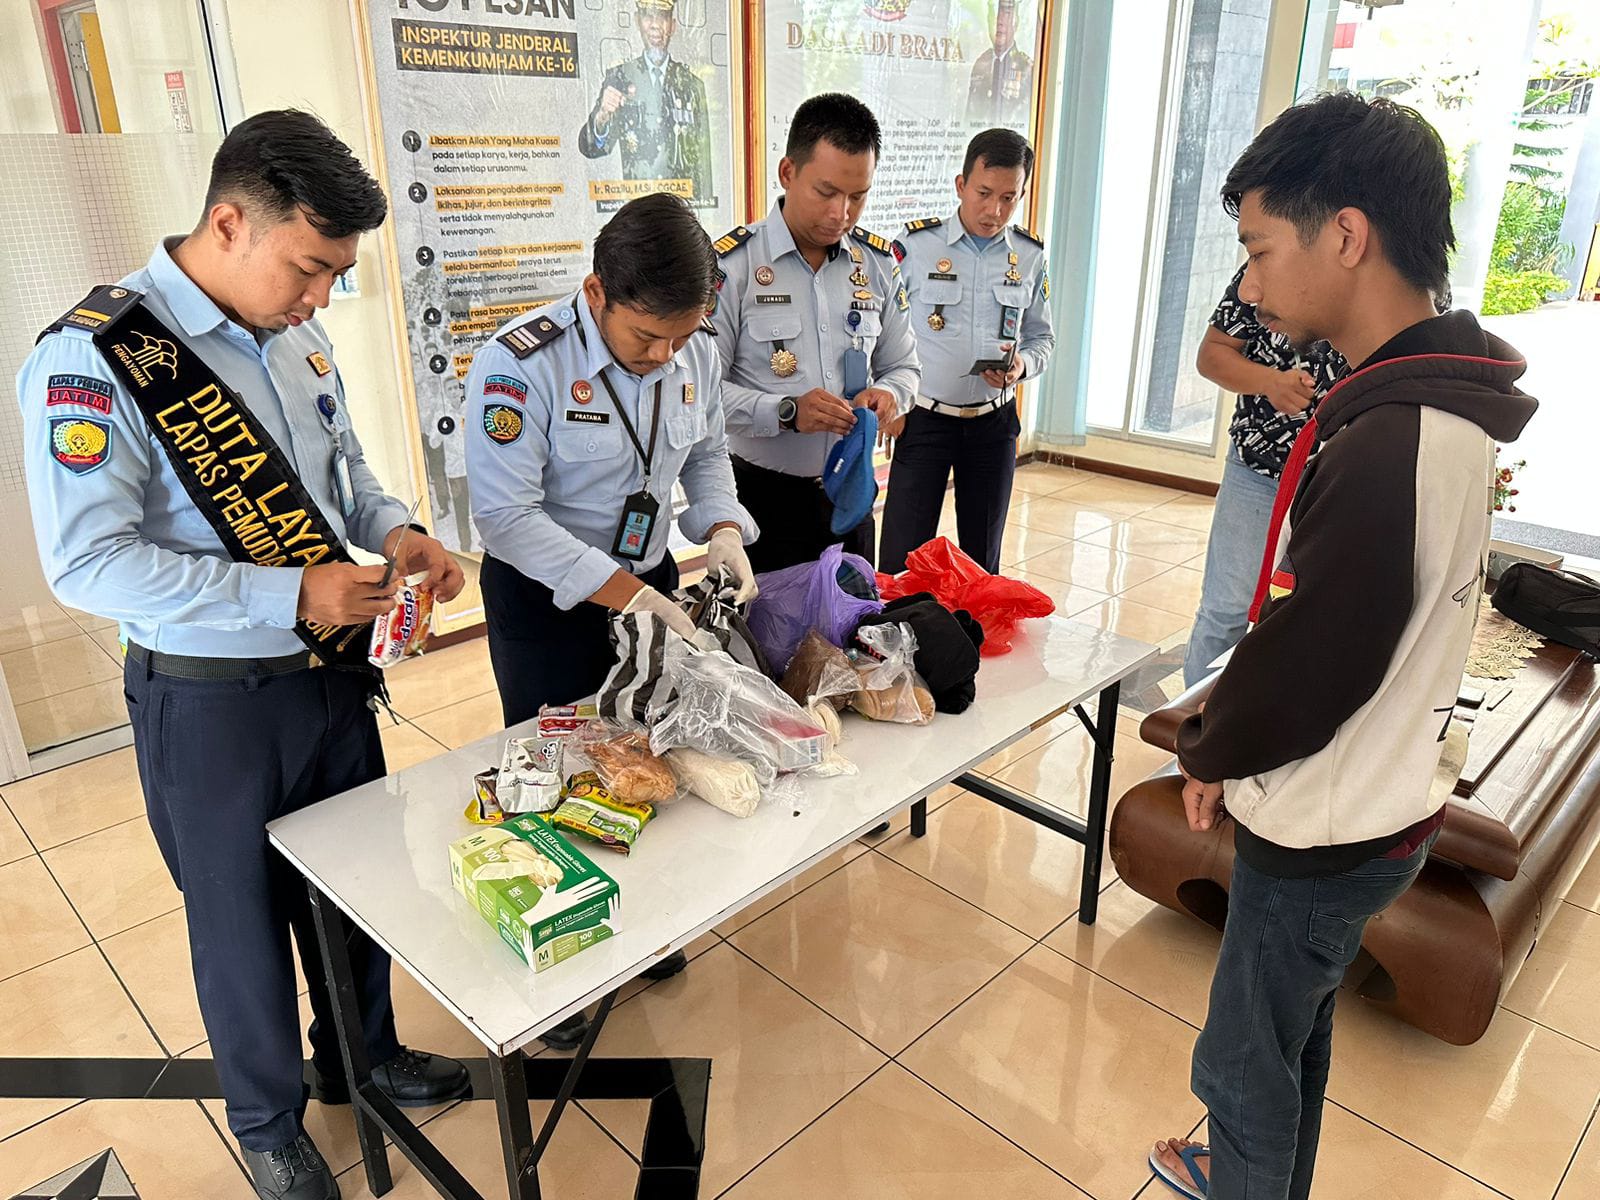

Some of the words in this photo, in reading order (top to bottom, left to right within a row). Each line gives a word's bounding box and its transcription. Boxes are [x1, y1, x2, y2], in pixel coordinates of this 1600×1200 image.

[402, 26, 492, 48] INSPEKTUR
[495, 33, 571, 53] JENDERAL
[900, 34, 965, 61] BRATA
[401, 48, 533, 71] KEMENKUMHAM
[537, 56, 575, 73] KE-16
[431, 136, 467, 145] Libatkan
[492, 136, 511, 147] Yang
[513, 136, 534, 145] Maha
[535, 136, 558, 145] Kuasa
[432, 151, 454, 161] pada
[456, 151, 480, 160] setiap
[532, 150, 560, 159] bahkan
[433, 165, 460, 173] dalam
[461, 164, 486, 174] setiap
[436, 187, 485, 196] Laksanakan
[487, 186, 533, 196] pengabdian
[534, 185, 562, 194] dengan
[465, 199, 486, 209] jujur,
[487, 199, 501, 208] dan
[503, 198, 551, 208] berintegritas
[439, 215, 461, 223] serta
[461, 213, 482, 222] tidak
[484, 211, 555, 223] menyalahgunakan
[441, 227, 495, 237] kewenangan.
[443, 250, 478, 258] Pastikan
[479, 247, 503, 257] setiap
[504, 246, 527, 256] karya
[528, 245, 542, 253] dan
[543, 243, 582, 254] kerjaanmu
[444, 262, 468, 272] selalu
[469, 260, 516, 270] bermanfaat
[517, 259, 542, 268] seraya
[543, 257, 561, 265] terus
[447, 275, 483, 285] torehkan
[484, 273, 519, 283] berbagai
[520, 271, 548, 280] prestasi
[549, 269, 567, 277] demi
[448, 287, 498, 298] kebanggaan
[499, 284, 539, 294] organisasi.
[471, 309, 488, 318] rasa
[489, 305, 521, 316] bangga,
[452, 323, 467, 331] dan
[469, 321, 496, 331] empati
[456, 356, 473, 365] Teru
[112, 345, 148, 389] PENGAYOMAN
[52, 377, 75, 386] LAPAS
[52, 390, 105, 408] JATIM
[575, 413, 602, 422] PRATAMA
[156, 401, 228, 487] LAPAS
[187, 383, 267, 482] DUTA
[255, 482, 330, 568] LAYA
[468, 835, 486, 847] M
[537, 829, 559, 846] LATEX
[554, 915, 572, 926] LATEX
[579, 931, 592, 942] 100
[538, 950, 549, 962] M
